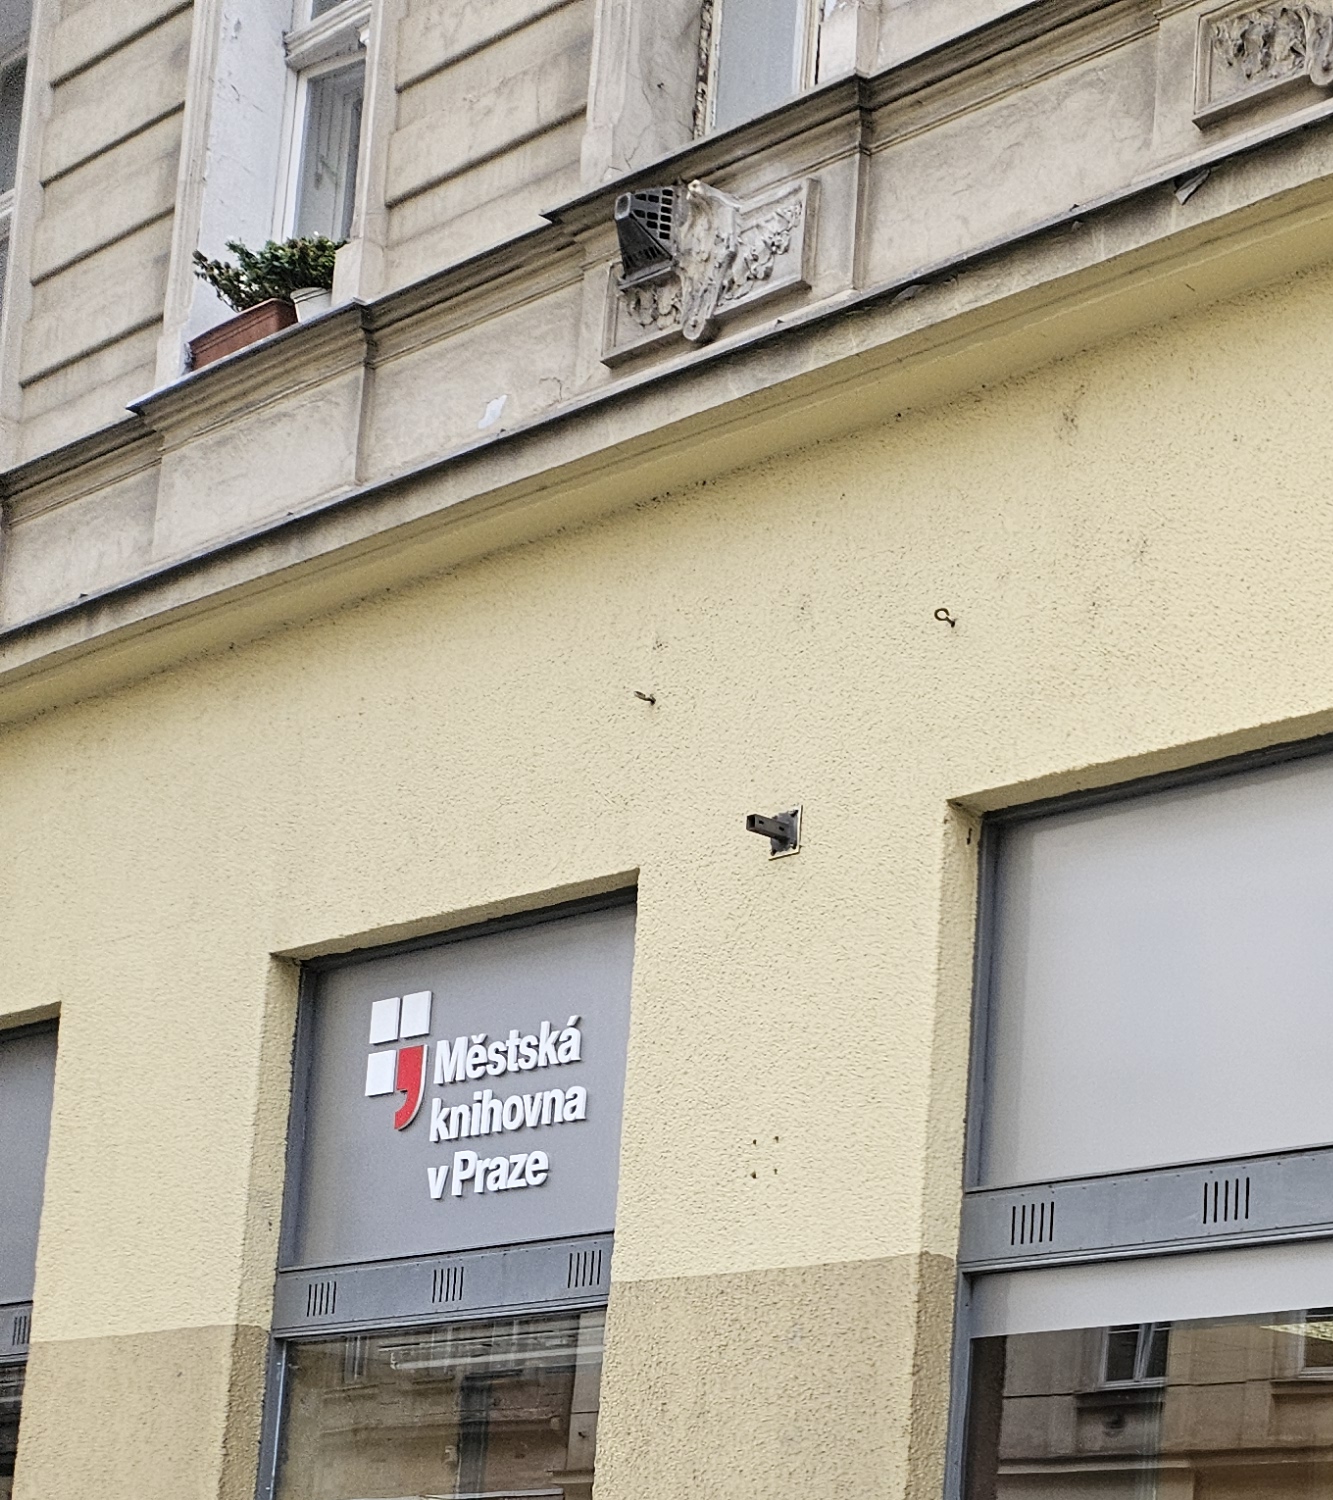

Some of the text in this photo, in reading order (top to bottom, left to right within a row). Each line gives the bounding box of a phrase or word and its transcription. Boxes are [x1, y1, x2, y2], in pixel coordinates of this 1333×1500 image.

[433, 1015, 582, 1085] Městská
[429, 1086, 588, 1142] knihovna
[427, 1150, 549, 1199] v Praze
